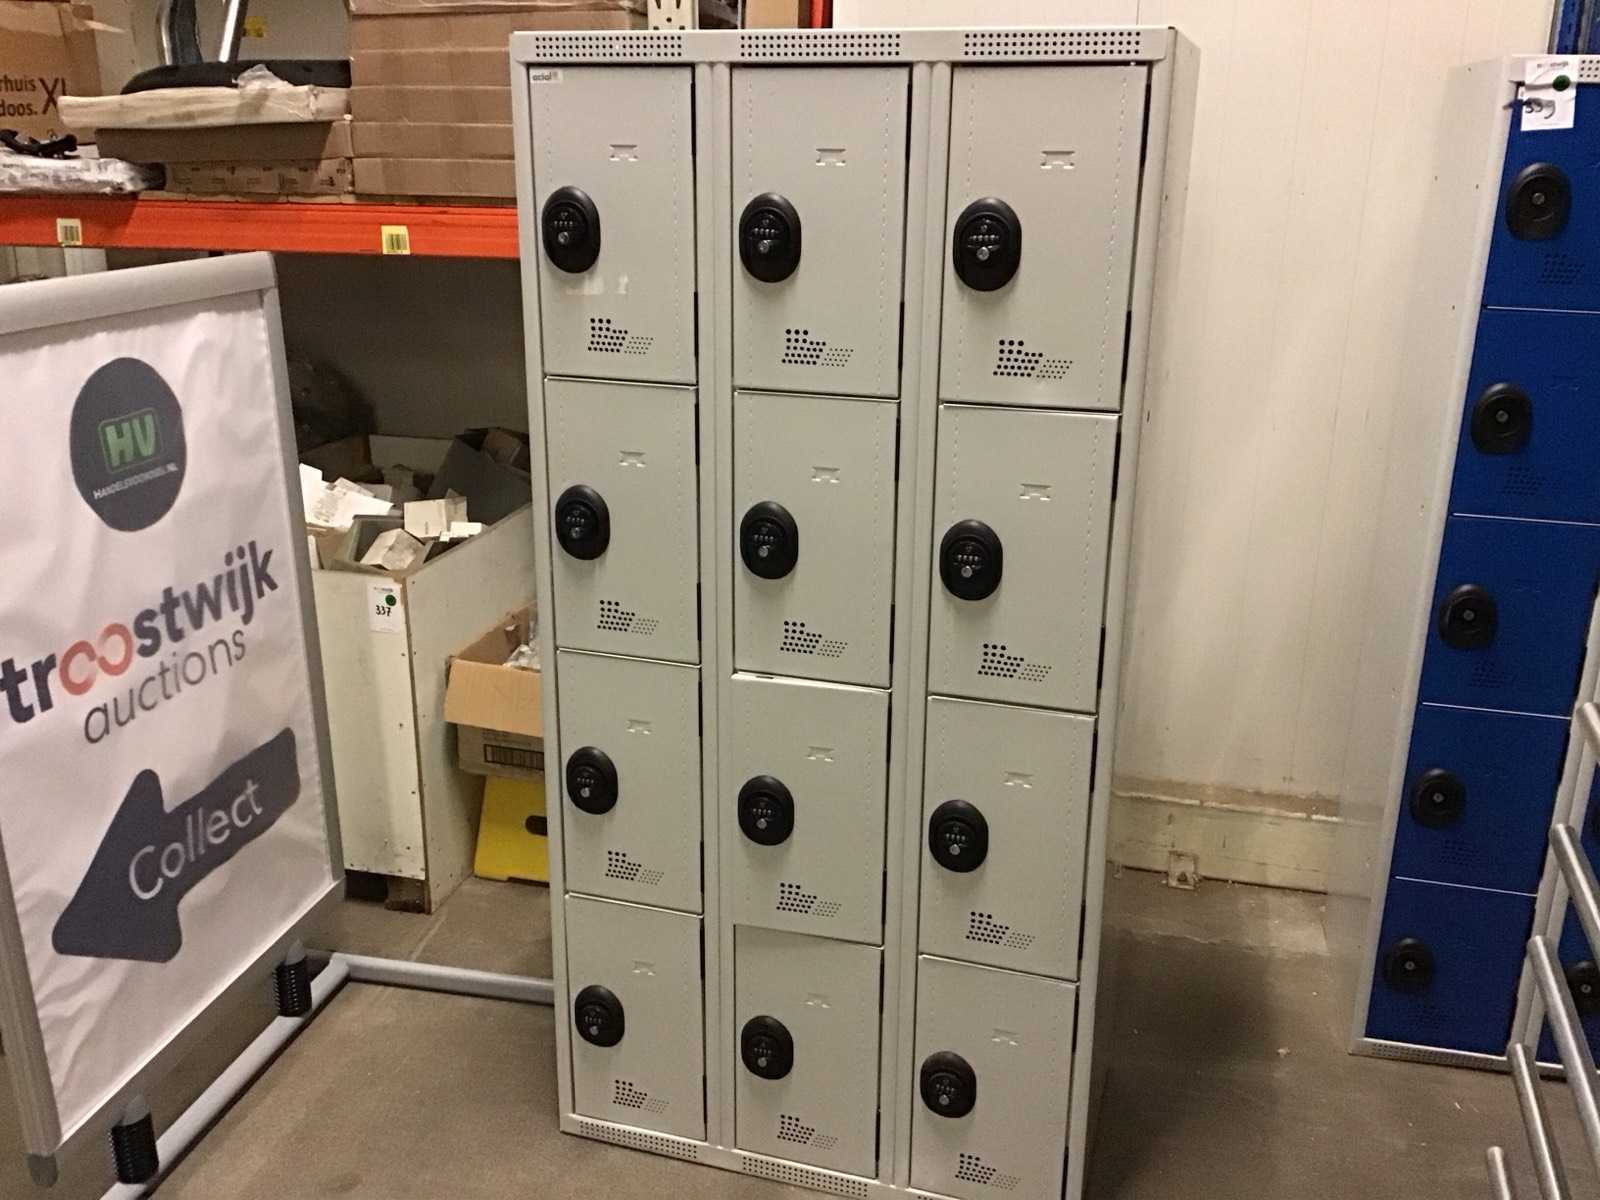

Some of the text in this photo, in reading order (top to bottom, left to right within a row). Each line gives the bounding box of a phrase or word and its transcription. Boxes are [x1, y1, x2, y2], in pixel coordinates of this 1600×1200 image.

[105, 414, 157, 467] HV
[0, 540, 278, 723] troostwijk
[375, 604, 392, 617] 337
[84, 629, 247, 744] auctions
[129, 779, 264, 901] Collect
